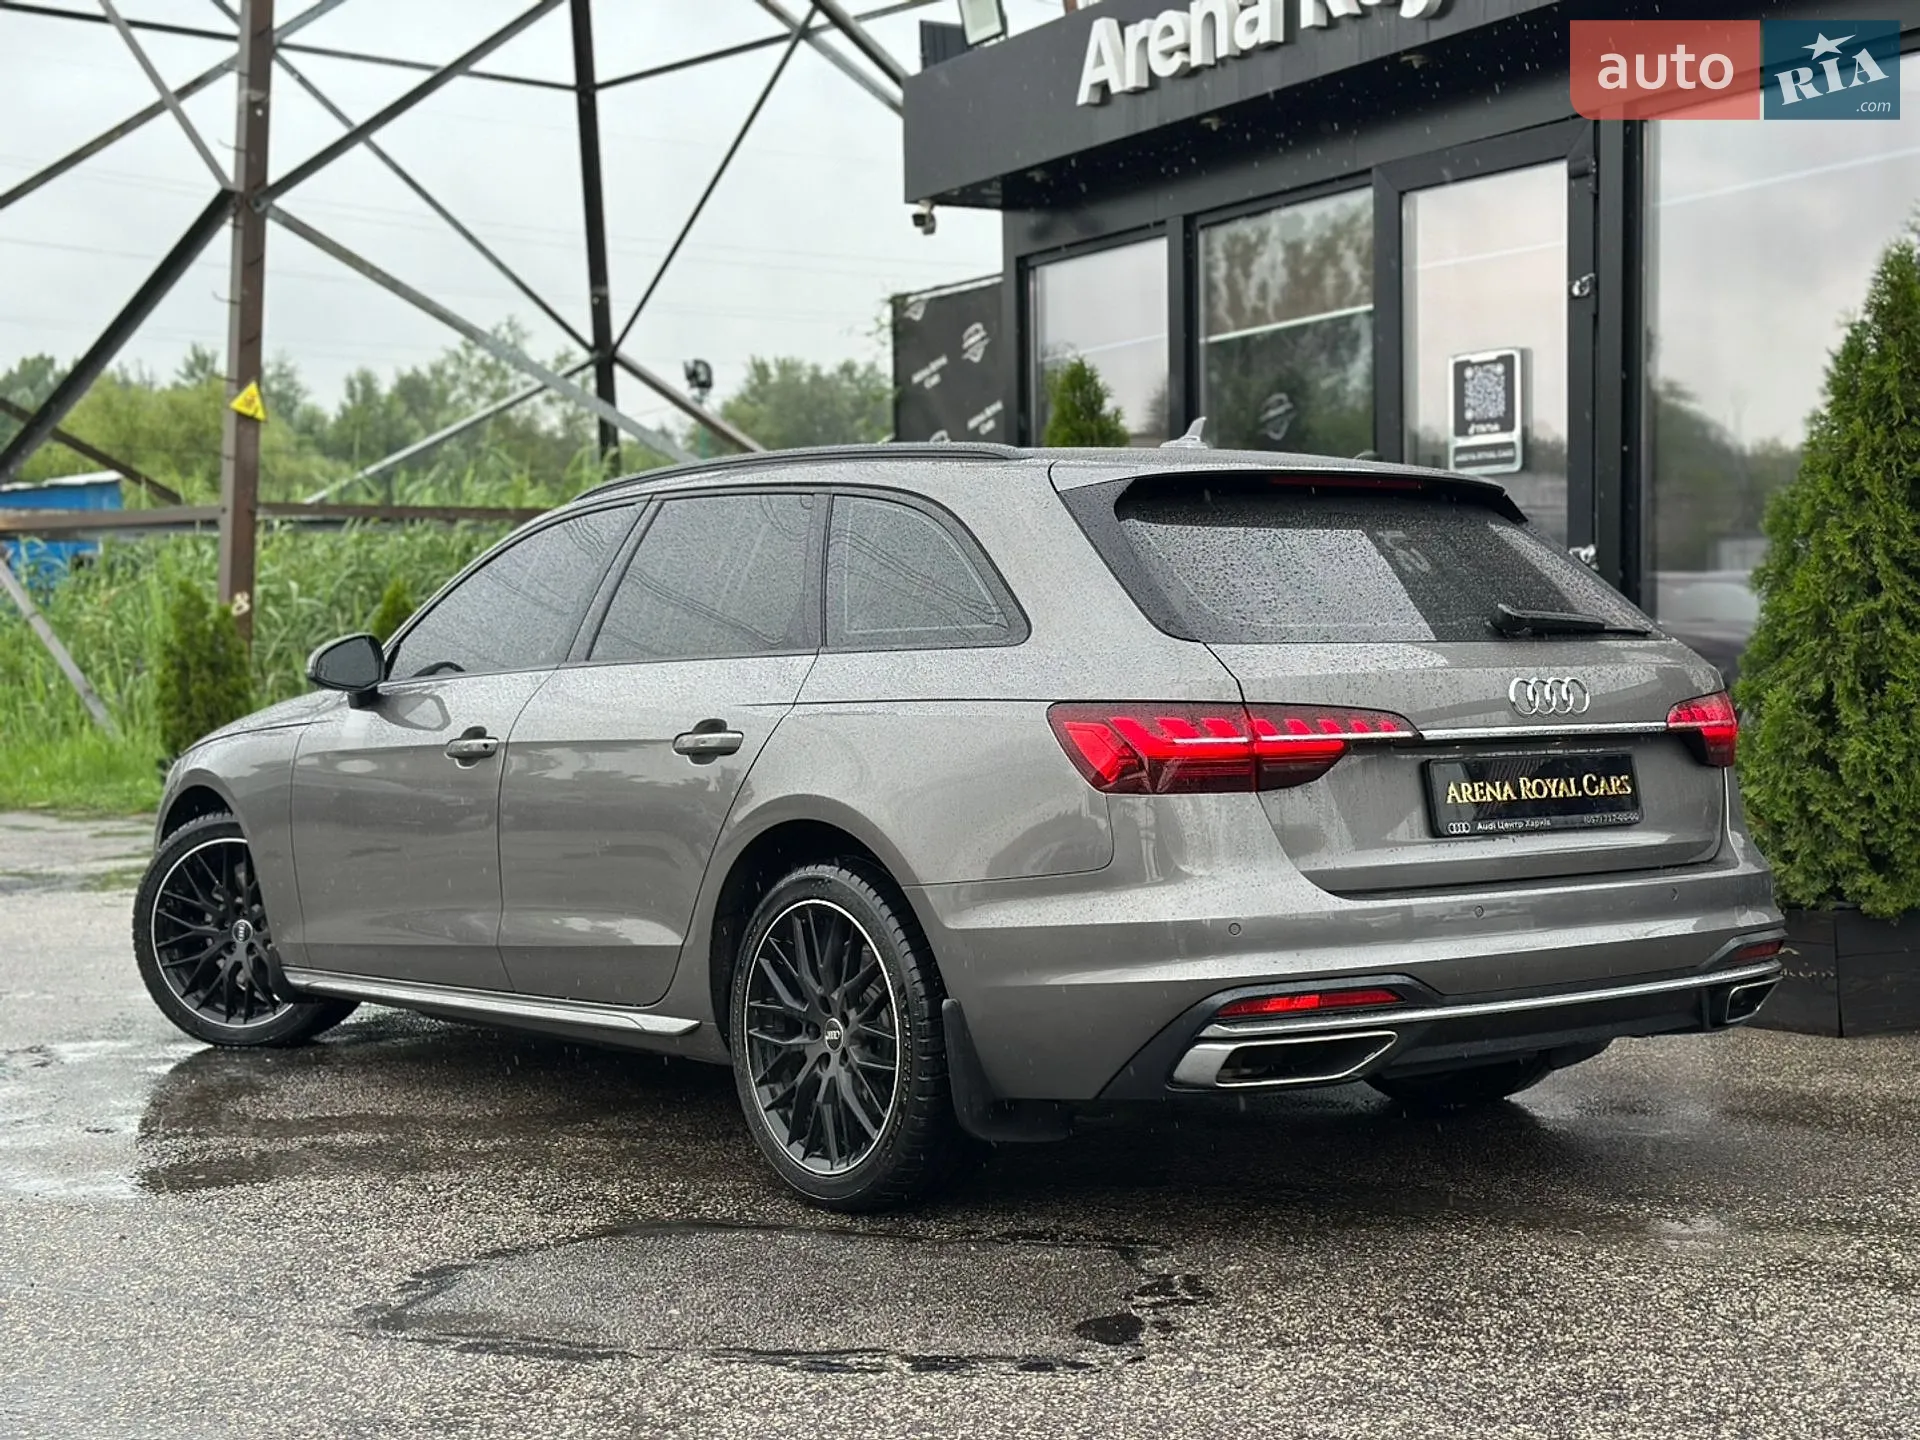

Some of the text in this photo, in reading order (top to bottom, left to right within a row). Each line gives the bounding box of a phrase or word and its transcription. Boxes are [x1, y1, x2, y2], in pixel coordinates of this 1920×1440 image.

[1076, 0, 1284, 106] Arena
[1446, 773, 1632, 804] ARENA ROYAL CARS
[1477, 821, 1497, 831] Audi
